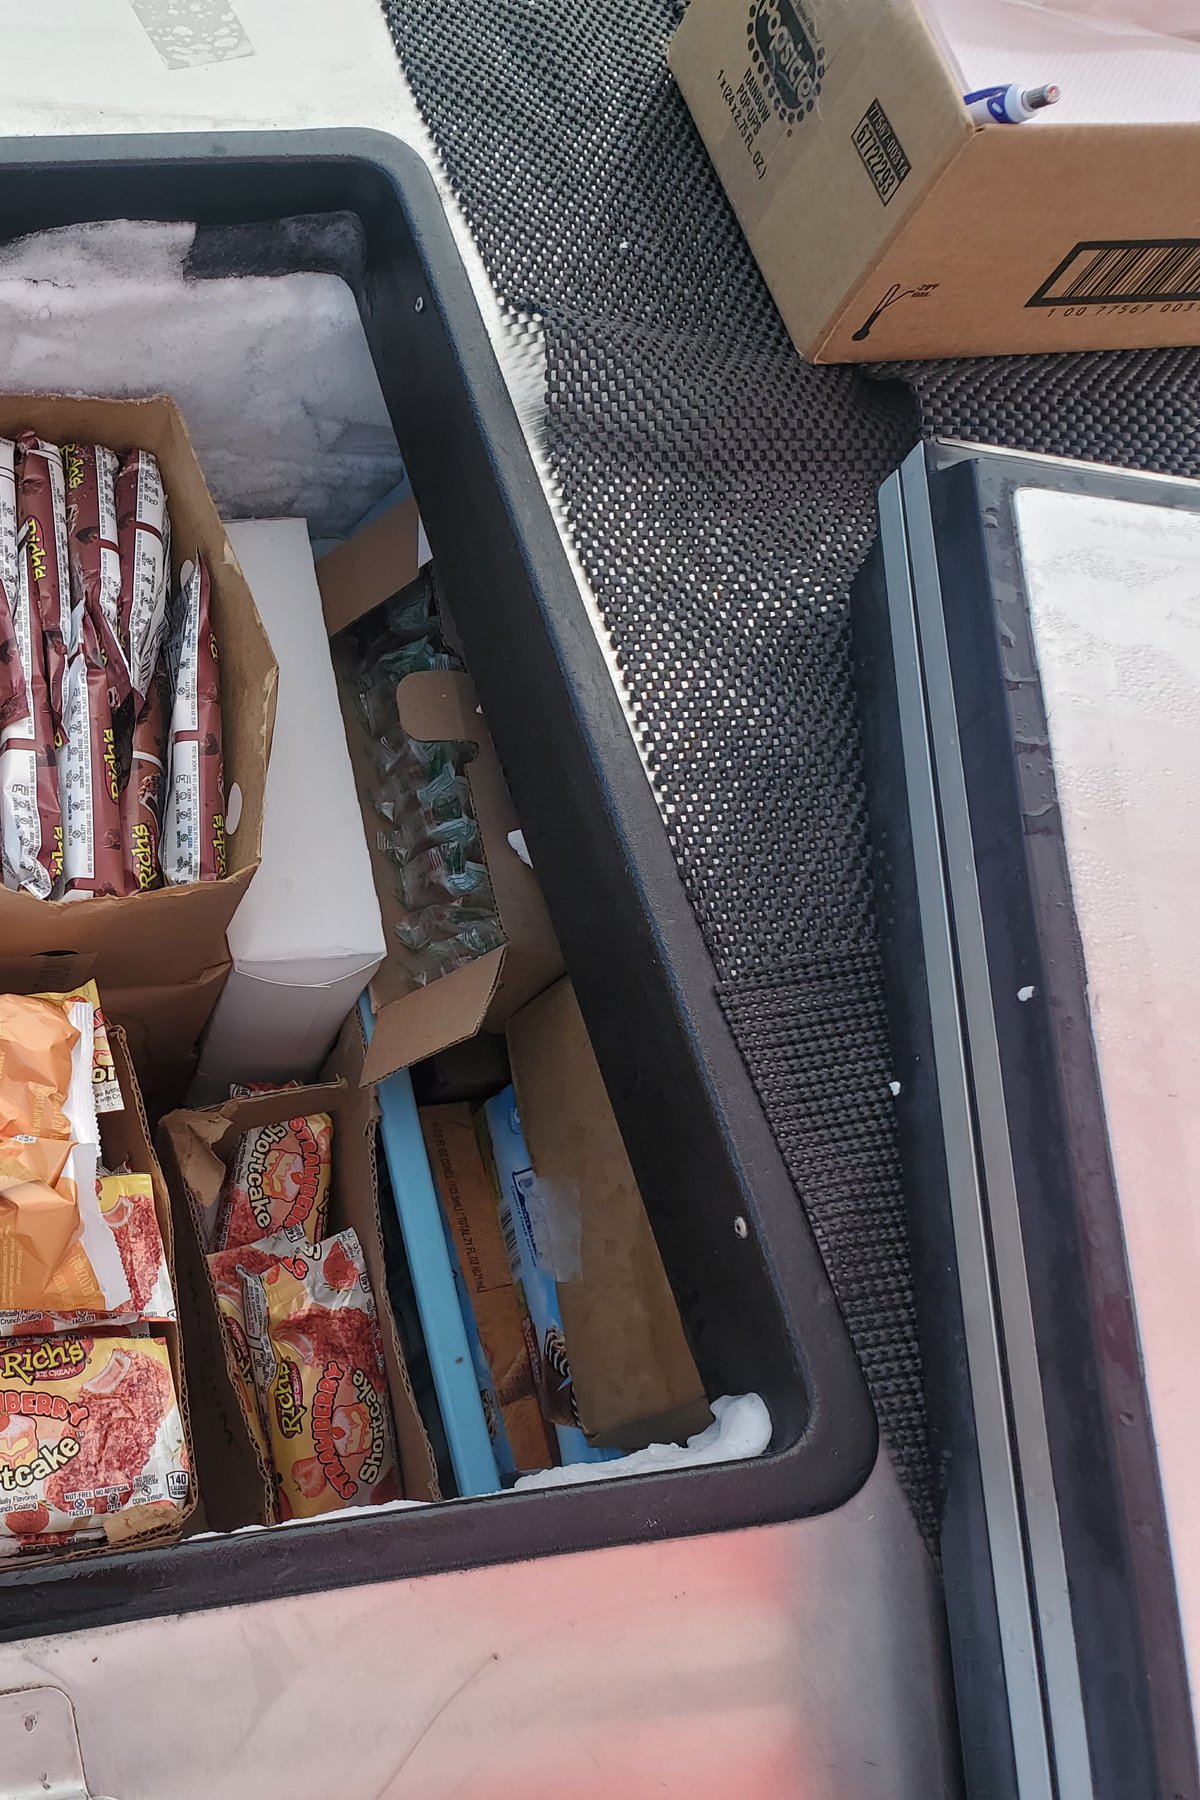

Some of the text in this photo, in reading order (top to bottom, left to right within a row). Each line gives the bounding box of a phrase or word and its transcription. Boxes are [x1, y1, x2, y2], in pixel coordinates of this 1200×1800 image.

[736, 82, 761, 136] POP-UPS
[743, 68, 770, 123] RAINBOW
[722, 86, 736, 107] (24
[734, 113, 748, 139] 2.75
[744, 137, 754, 156] FL.
[753, 151, 769, 180] OZ.)
[869, 103, 908, 180] 77567-00314
[856, 123, 896, 196] 67722293
[1046, 304, 1153, 318] 1 00 77567
[131, 823, 158, 890] Rich's
[248, 1123, 288, 1229] Shortcake
[441, 1158, 455, 1180] CONES
[458, 1216, 471, 1237] TOTAL
[0, 1316, 21, 1326] Crunch
[22, 1312, 42, 1322] Coating
[1, 1341, 86, 1383] Rich's
[35, 1365, 77, 1380] ICE CREAM
[279, 1361, 309, 1436] Rich's
[312, 1361, 358, 1499] STRAWBERRY
[352, 1368, 384, 1485] Shortcake
[12, 1493, 39, 1503] Flavored
[64, 1489, 93, 1501] NUT FREE
[96, 1485, 131, 1497] NO ARTIFICIAL
[141, 1473, 157, 1482] HIGH
[169, 1474, 188, 1486] 140
[12, 1500, 38, 1513] Coating
[68, 1508, 94, 1518] FACILITY
[132, 1494, 164, 1505] CORN SYRUP
